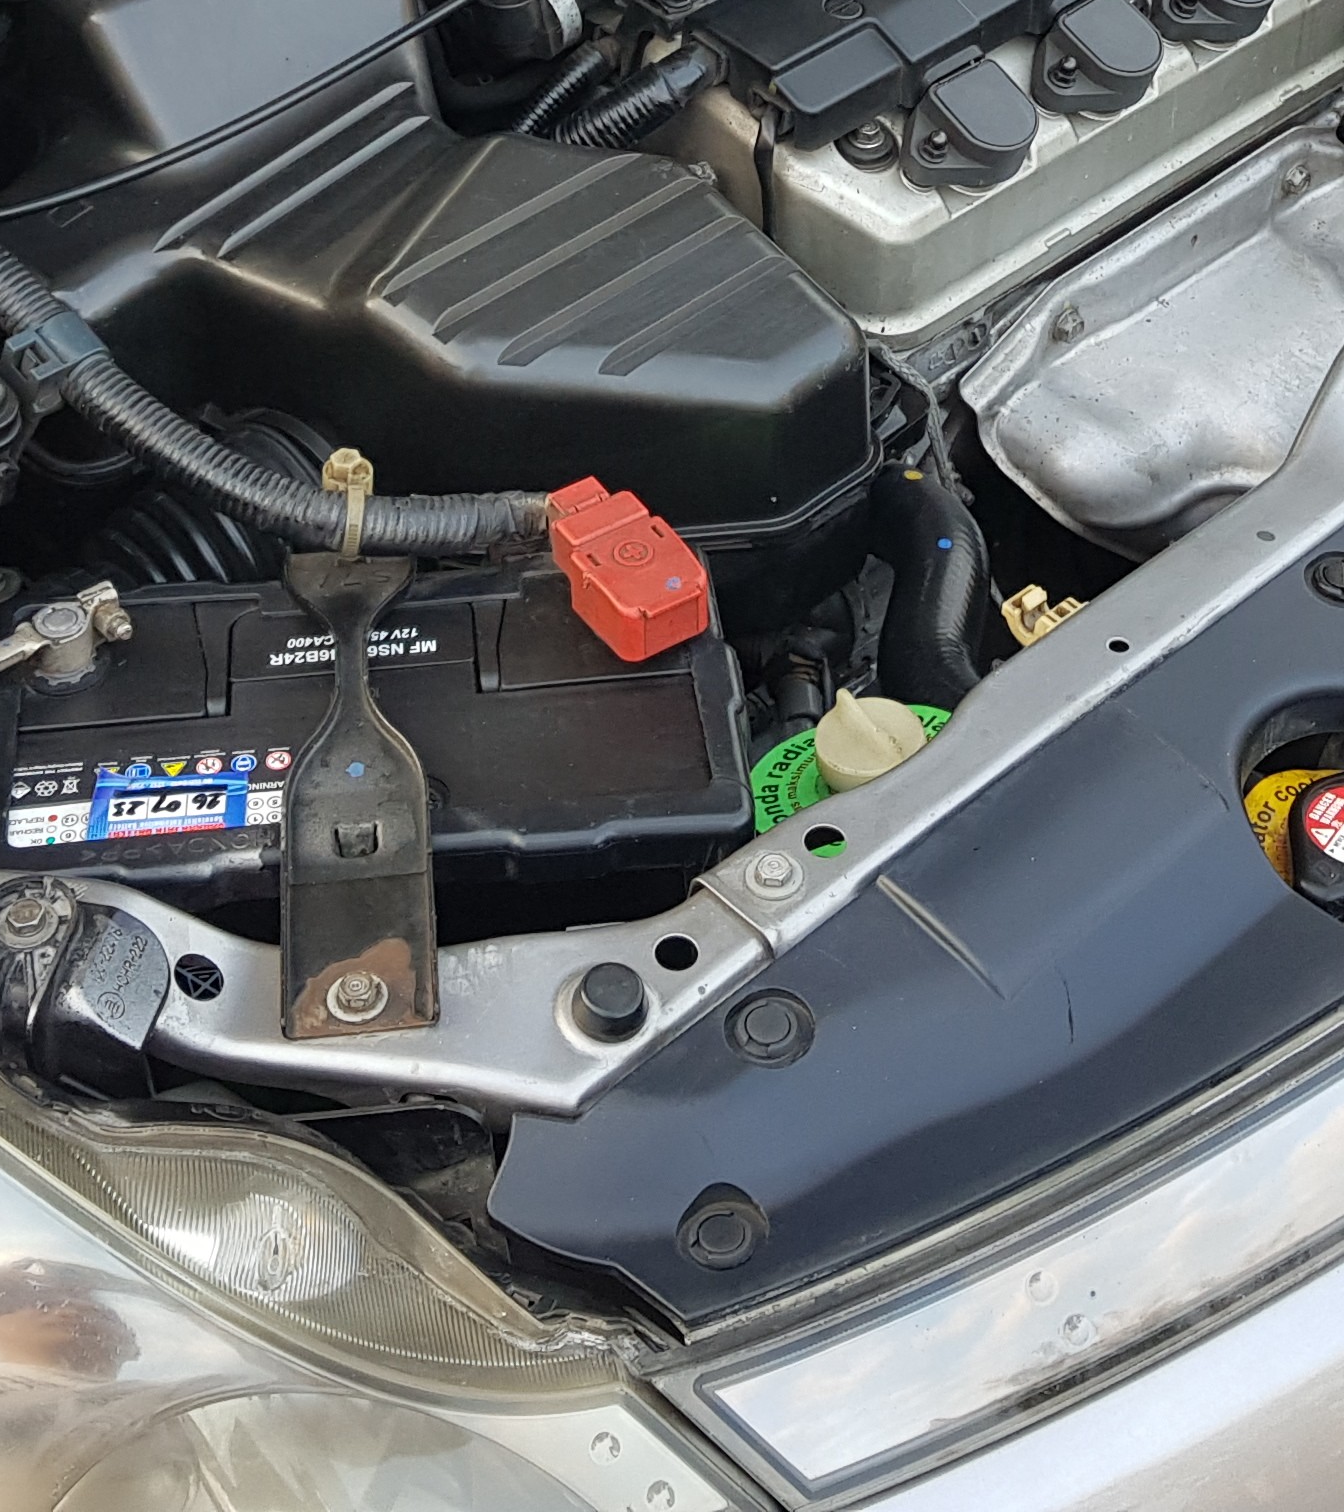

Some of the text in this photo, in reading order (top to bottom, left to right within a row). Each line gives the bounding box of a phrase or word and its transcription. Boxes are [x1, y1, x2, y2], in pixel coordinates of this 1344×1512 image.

[390, 627, 418, 639] 12V
[409, 640, 437, 654] MF
[191, 792, 220, 810] 26
